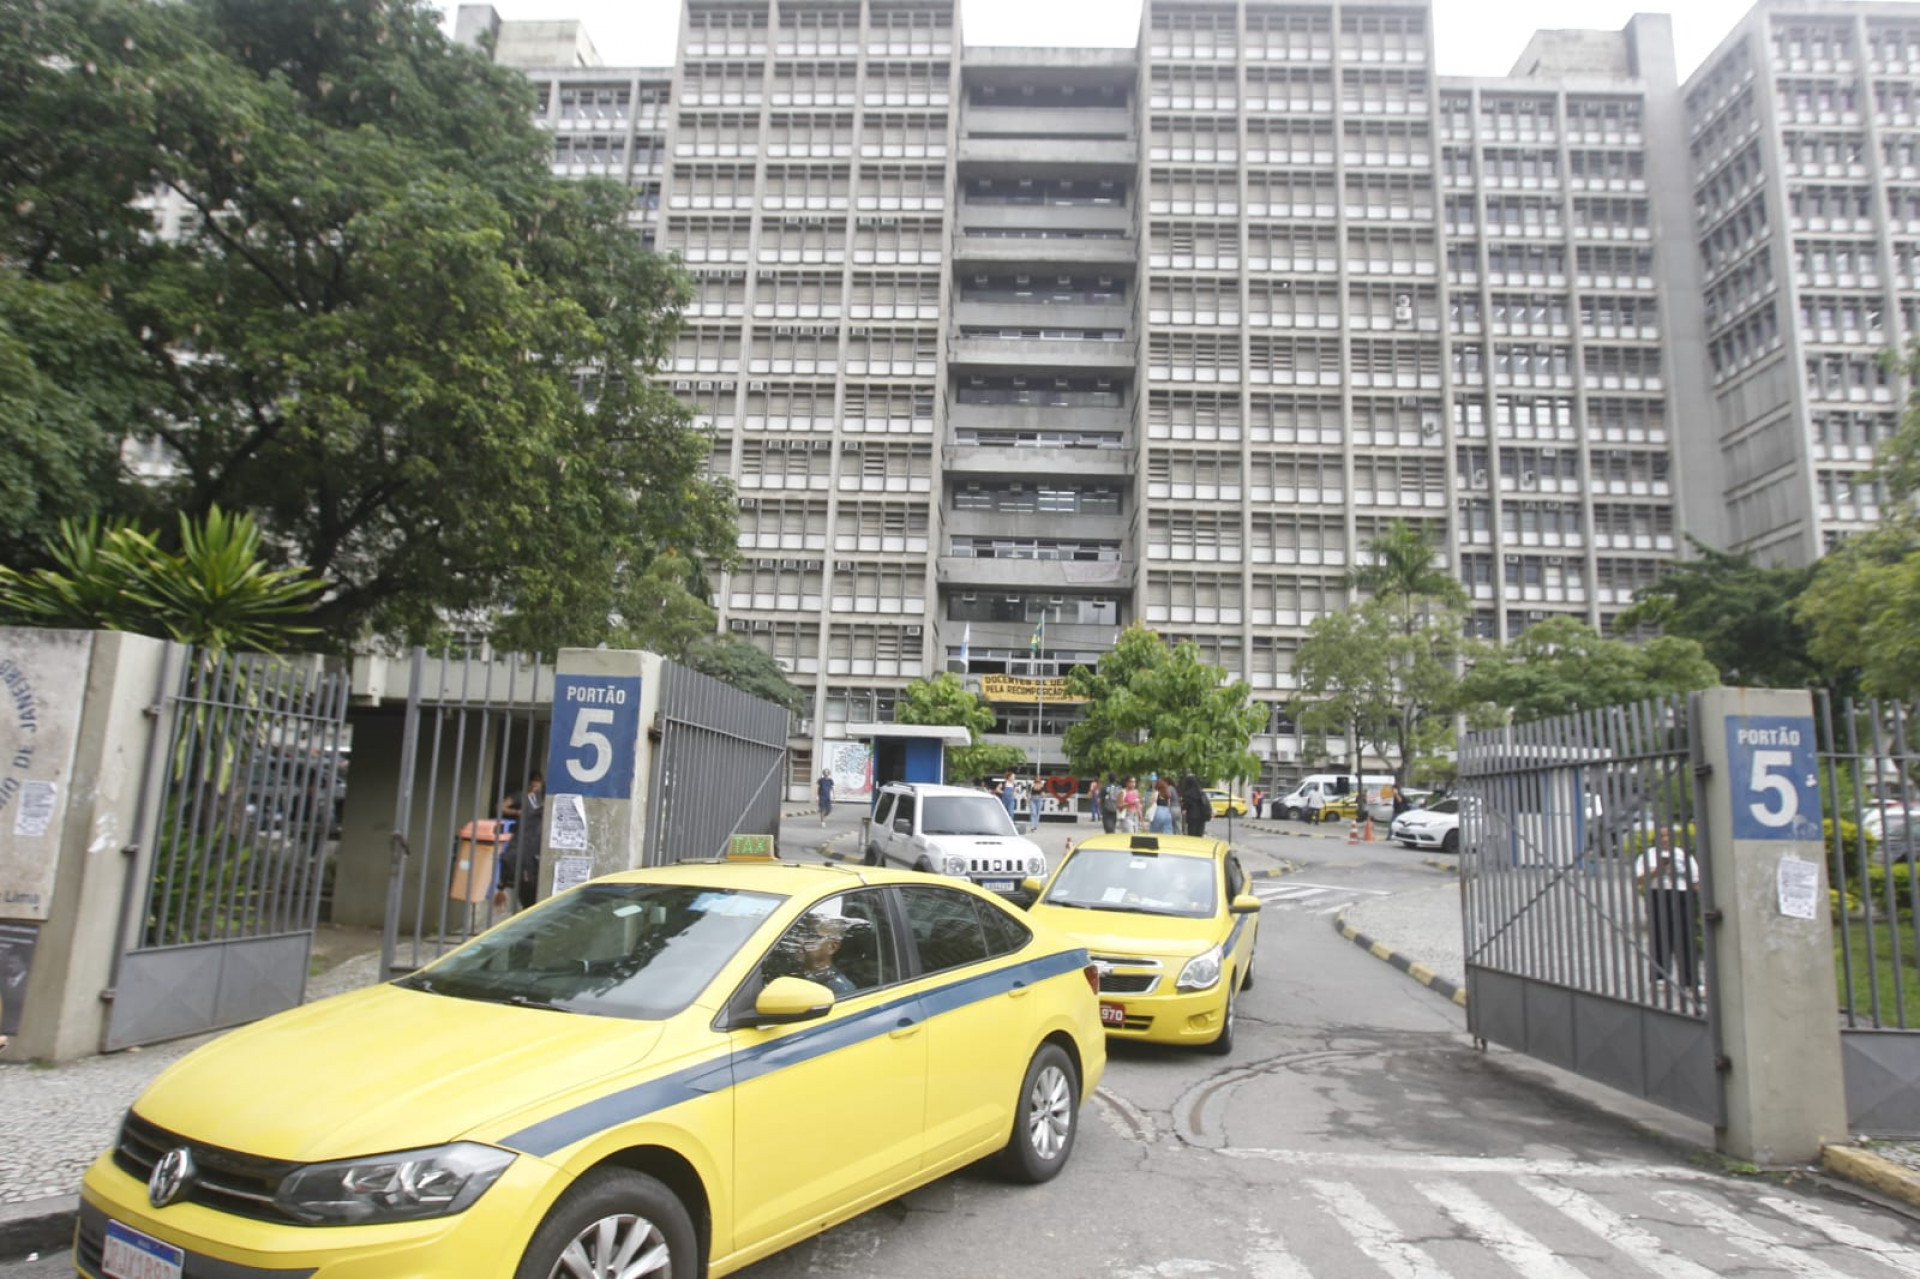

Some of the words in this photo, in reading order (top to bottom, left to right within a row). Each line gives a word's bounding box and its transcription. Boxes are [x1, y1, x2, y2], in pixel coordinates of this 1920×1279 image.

[567, 685, 626, 704] PORTÃO
[984, 685, 1004, 694] PELA
[566, 707, 615, 783] 5
[1738, 726, 1801, 746] PORTÃO
[13, 746, 33, 769] DE
[1749, 750, 1798, 828] 5
